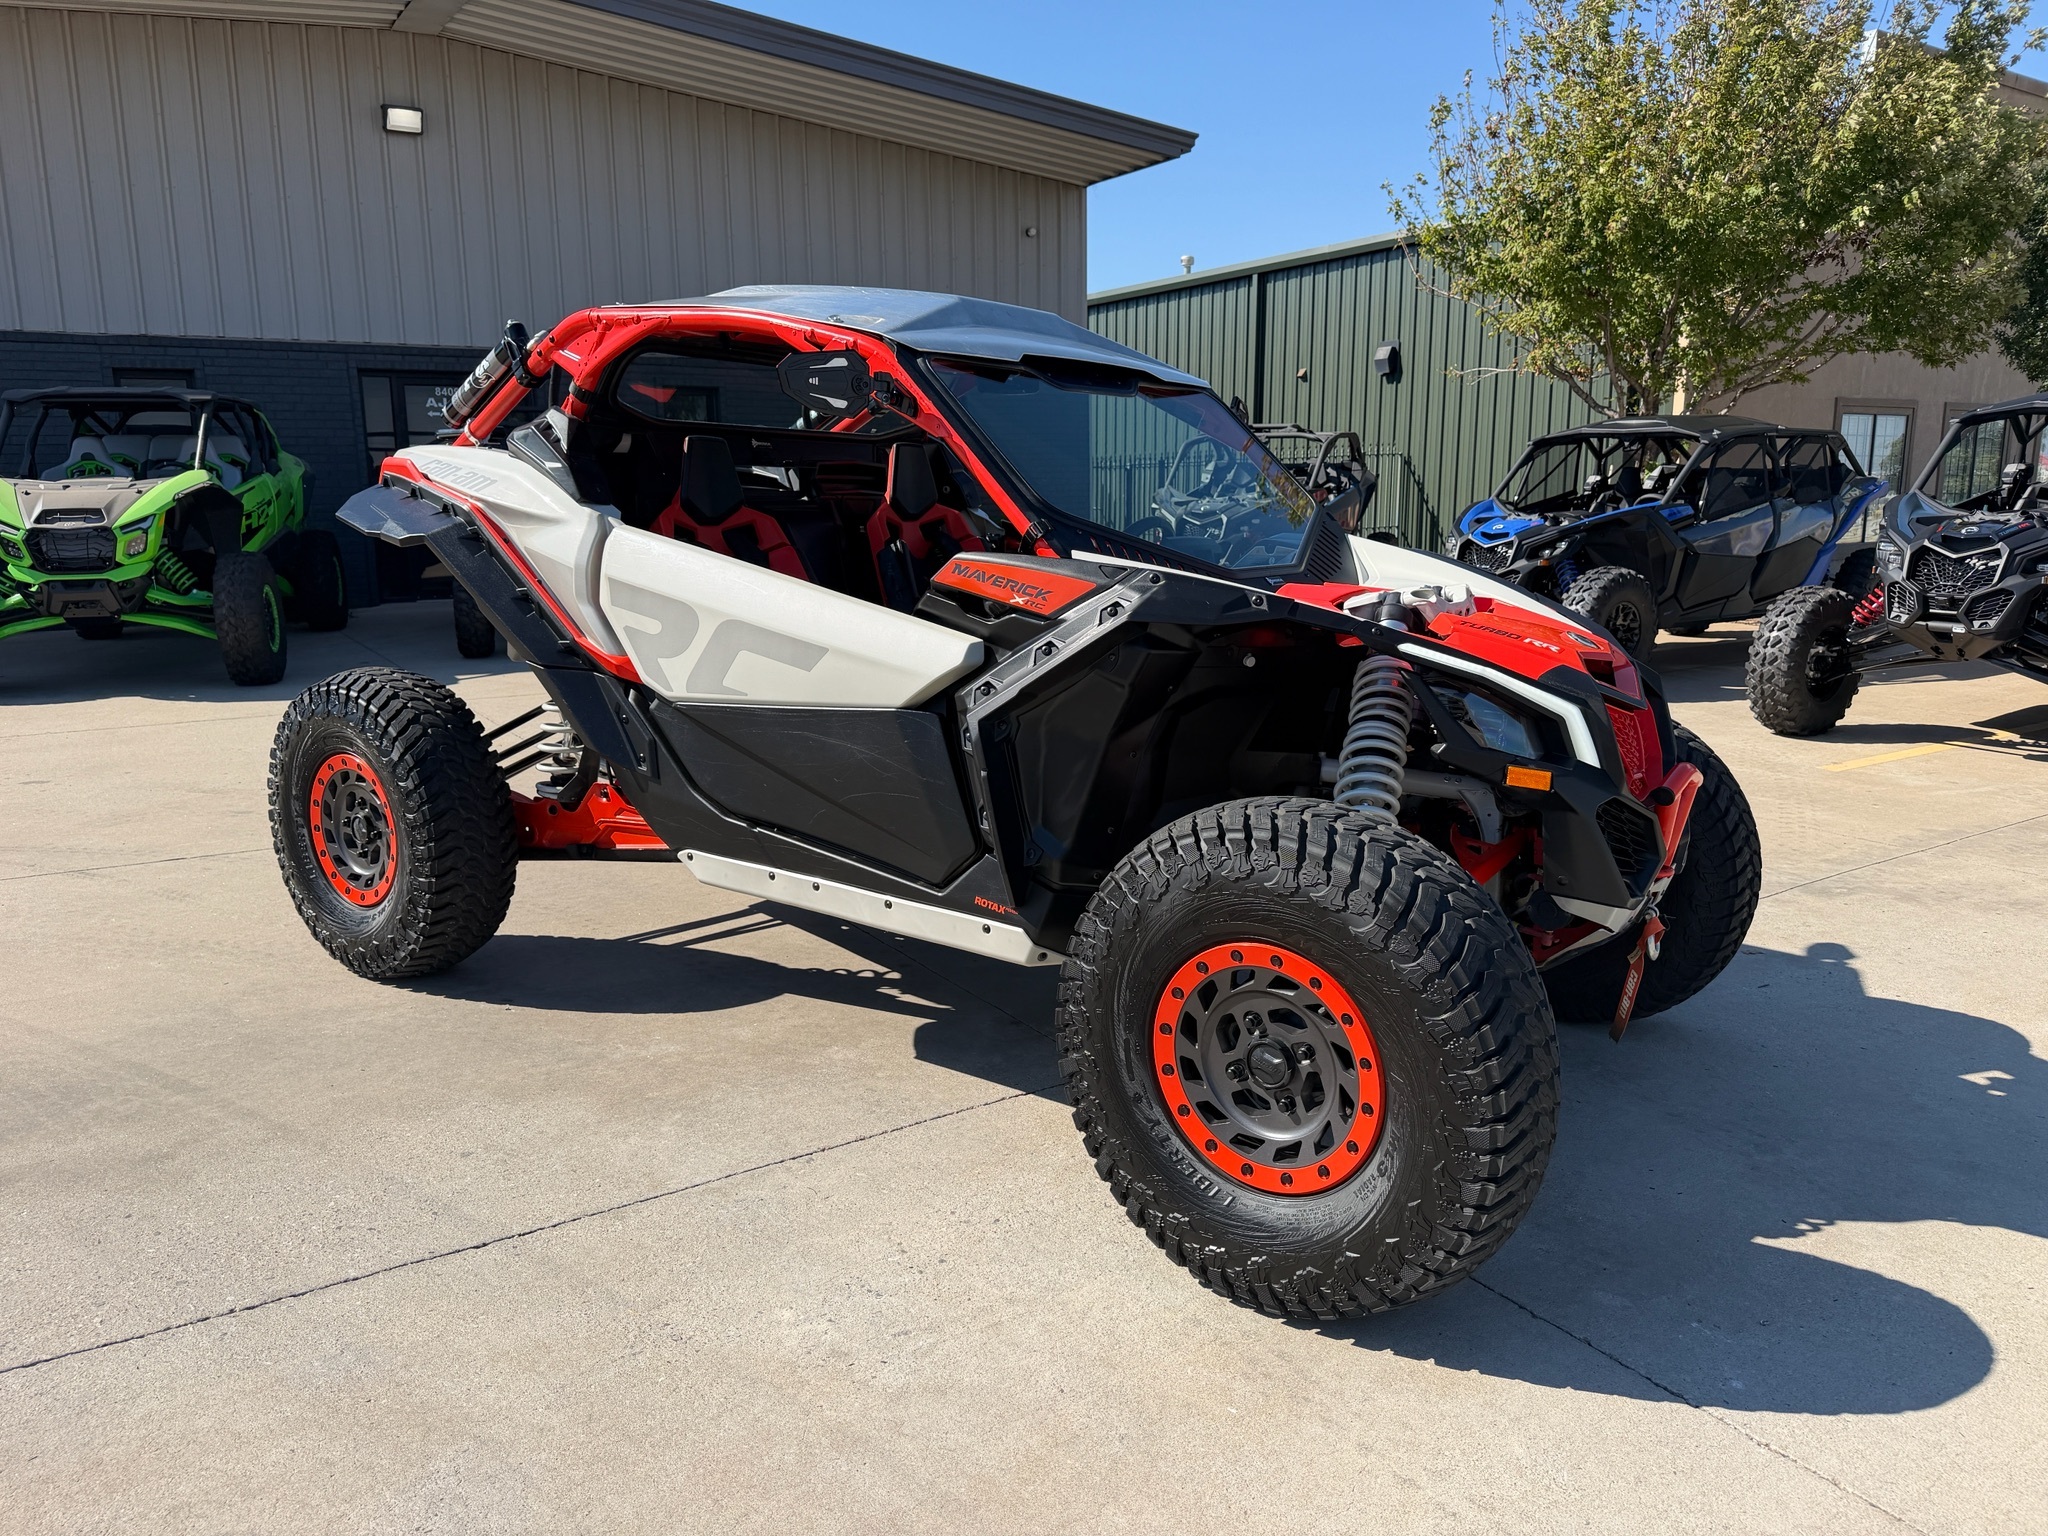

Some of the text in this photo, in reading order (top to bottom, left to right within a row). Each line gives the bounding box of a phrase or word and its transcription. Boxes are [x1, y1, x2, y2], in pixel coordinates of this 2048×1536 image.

[419, 459, 498, 493] can-am
[951, 562, 1053, 602] MAVERICK
[607, 576, 830, 697] RC
[1460, 620, 1561, 653] TURBO RR
[974, 896, 1005, 914] ROTAX
[1619, 969, 1639, 1019] can-am
